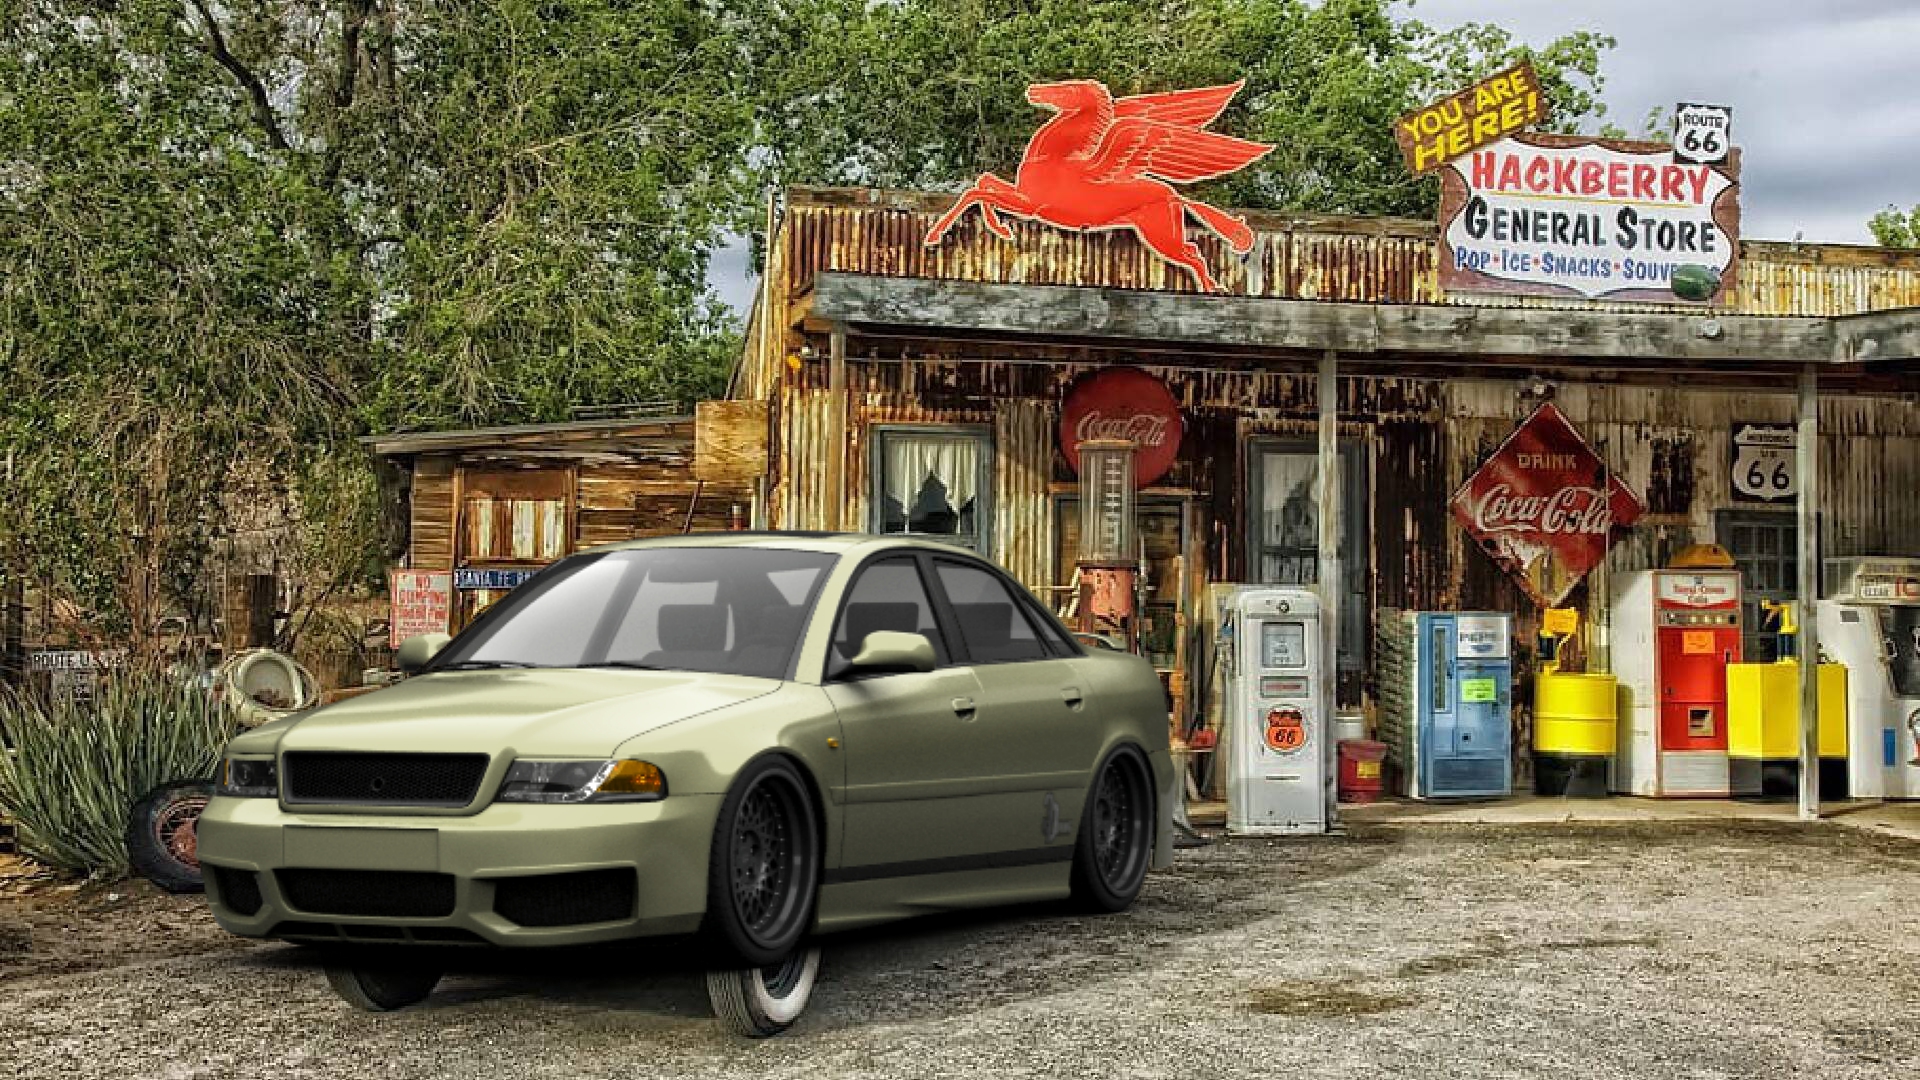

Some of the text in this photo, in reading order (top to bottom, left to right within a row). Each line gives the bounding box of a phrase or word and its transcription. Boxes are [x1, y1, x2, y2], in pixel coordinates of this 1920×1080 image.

[1403, 68, 1529, 141] YOU ARE
[1683, 113, 1723, 129] ROUTE
[1415, 92, 1537, 171] HERE!
[1683, 131, 1721, 152] 66
[1472, 152, 1710, 205] HACKBERRY
[1464, 195, 1716, 253] GENERAL STORE
[1456, 245, 1491, 269] POP
[1501, 249, 1531, 273] ICE
[1541, 252, 1611, 279] SNACKS
[1516, 453, 1577, 470] DRINK
[1746, 460, 1790, 490] 66
[1475, 483, 1616, 534] Coca-Cola
[1274, 729, 1296, 744] 66
